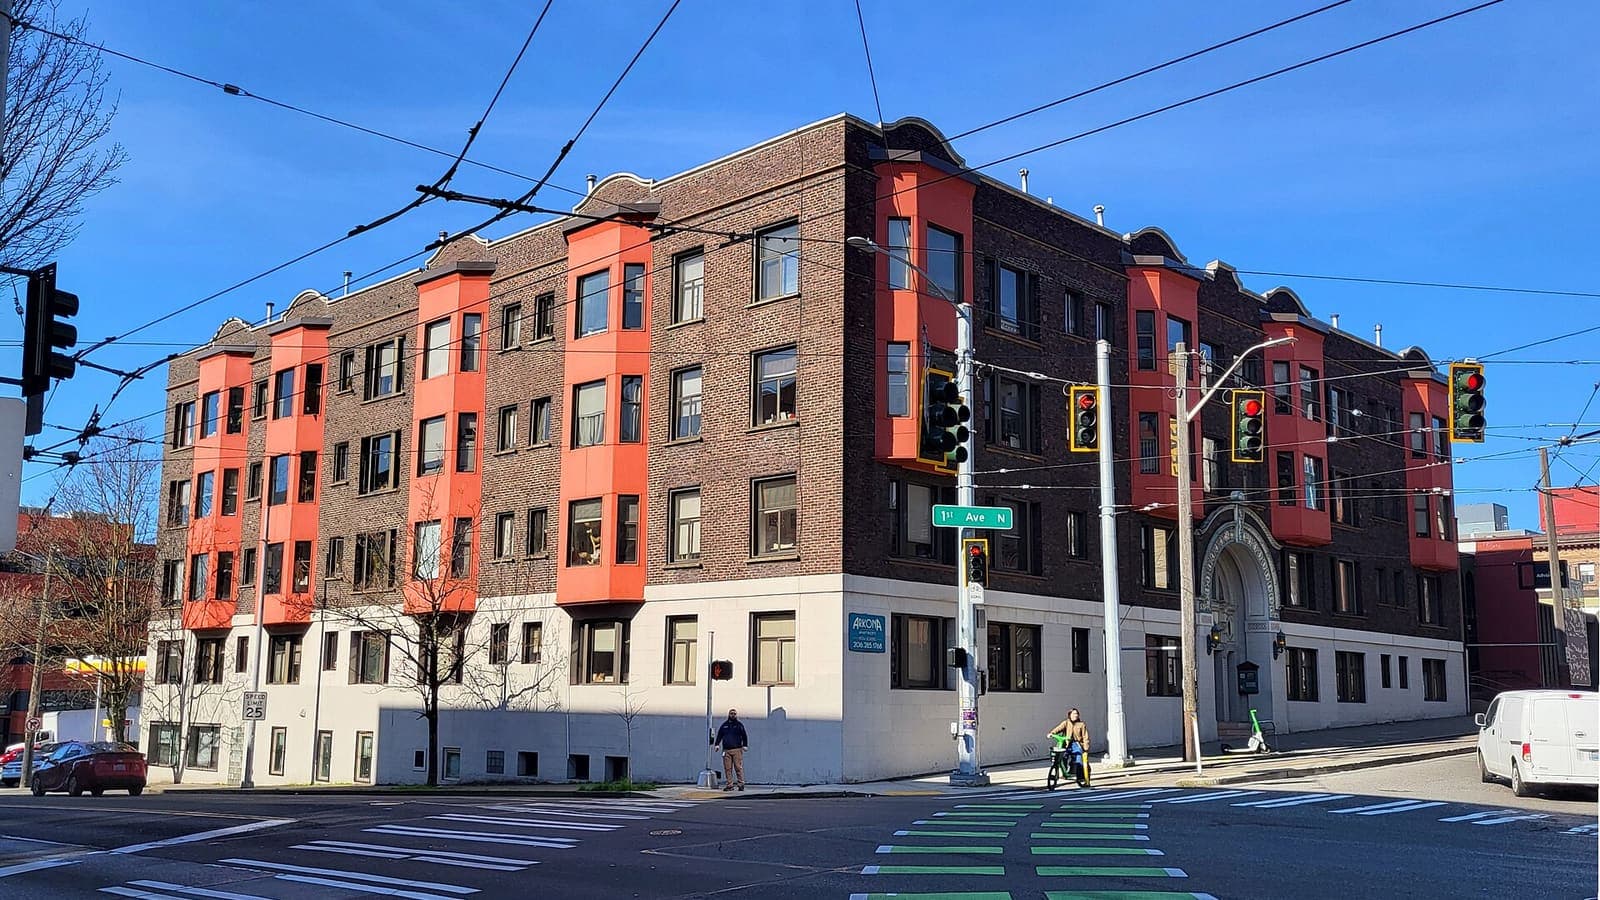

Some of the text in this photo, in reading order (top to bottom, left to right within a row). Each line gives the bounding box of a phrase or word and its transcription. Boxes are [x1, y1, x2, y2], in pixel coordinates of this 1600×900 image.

[941, 511, 1006, 523] 1st Ave N
[852, 616, 882, 631] ARKONA
[246, 707, 263, 718] 25
